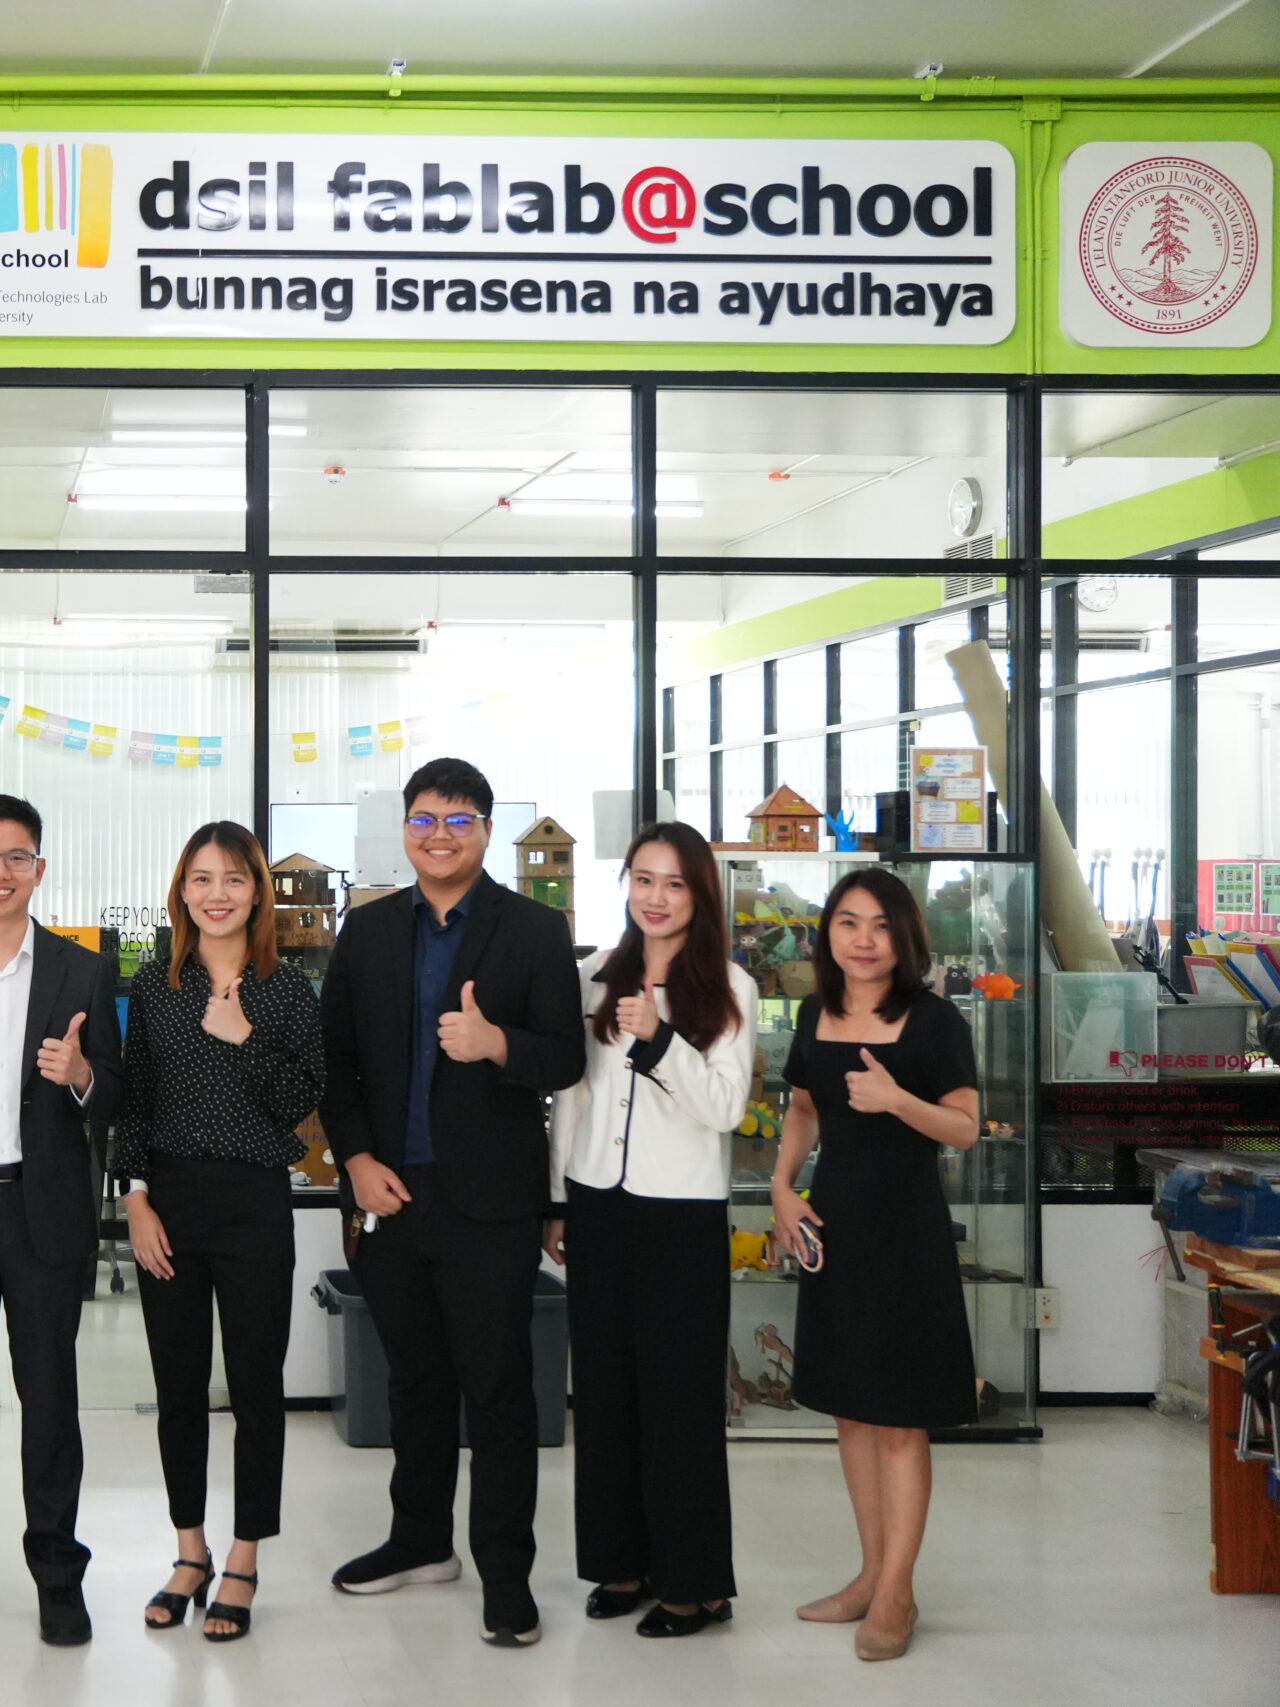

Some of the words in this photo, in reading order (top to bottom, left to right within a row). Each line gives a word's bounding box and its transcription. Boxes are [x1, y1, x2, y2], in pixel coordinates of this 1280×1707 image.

[139, 160, 294, 231] dsil
[327, 161, 993, 243] fablab@school
[1137, 193, 1157, 207] DER
[1179, 193, 1214, 222] FREIHEIT
[1093, 214, 1109, 269] LELAND
[1103, 170, 1166, 215] STANFORD
[1167, 170, 1216, 197] JUNIOR
[1214, 191, 1246, 269] UNIVERSITY
[1118, 206, 1136, 229] LUFT
[1114, 229, 1124, 247] DIE
[1211, 222, 1223, 247] WEHT
[84, 291, 108, 304] Lab
[140, 265, 354, 322] bunnag
[376, 267, 611, 314] israsena
[633, 280, 700, 315] na
[719, 271, 994, 326] ayudhaya
[1155, 309, 1183, 321] 1891
[100, 906, 130, 926] KEEP
[133, 906, 167, 927] YOUR
[1141, 1054, 1209, 1068] PLEASE
[1214, 1054, 1270, 1069] DON'T
[1072, 1085, 1104, 1098] Bring
[1120, 1085, 1148, 1096] food
[1151, 1087, 1165, 1096] or
[1168, 1084, 1199, 1096] drink
[1072, 1100, 1113, 1112] Disturb
[1118, 1100, 1155, 1112] others
[1159, 1101, 1184, 1112] with
[1187, 1101, 1239, 1112] intention
